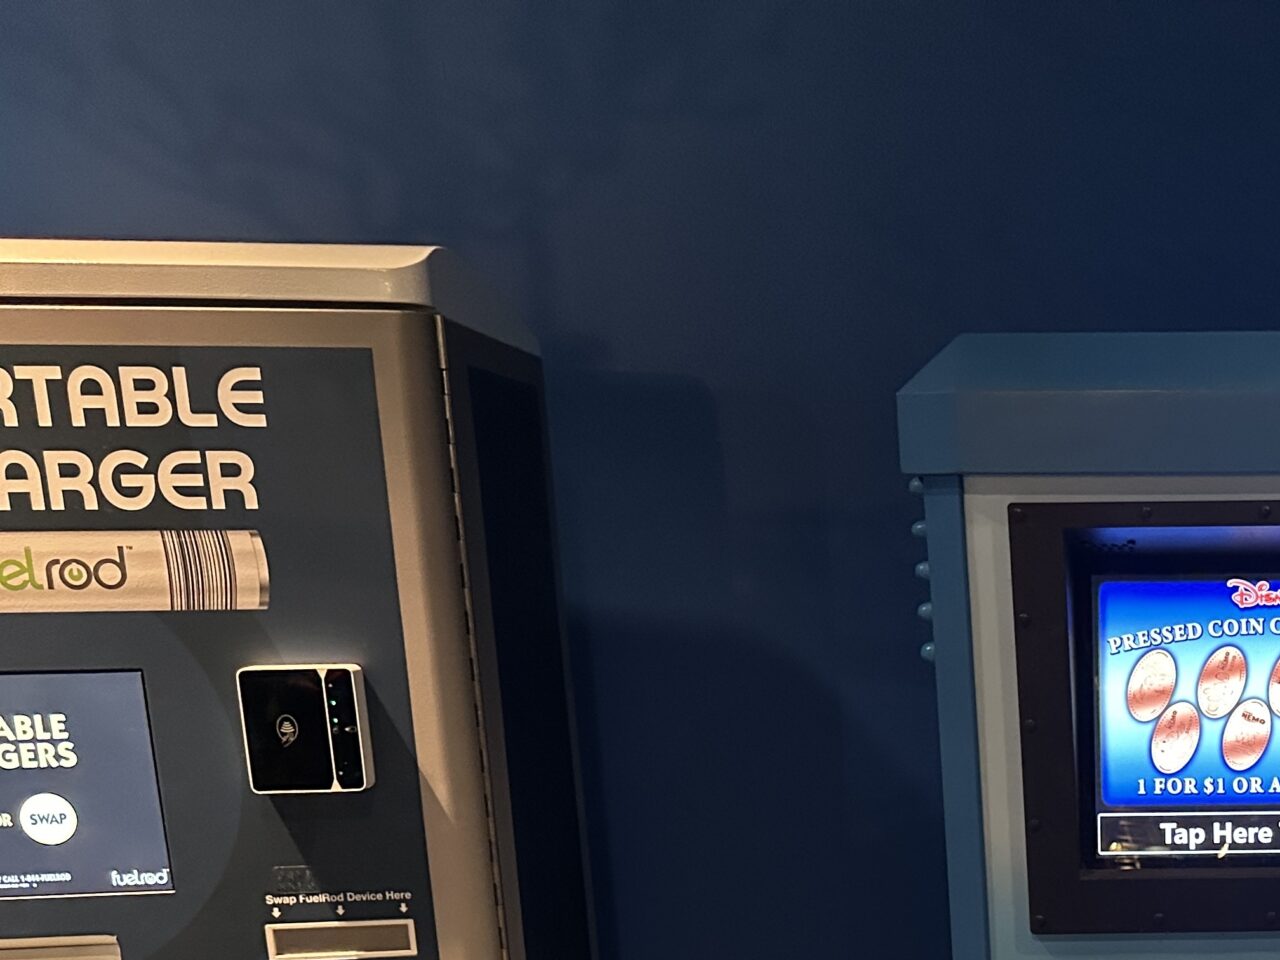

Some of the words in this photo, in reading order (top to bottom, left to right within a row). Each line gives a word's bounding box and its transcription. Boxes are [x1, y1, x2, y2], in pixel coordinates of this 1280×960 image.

[1107, 622, 1202, 655] PRESSED
[1208, 617, 1264, 637] COIN
[1241, 712, 1266, 725] NEMO
[0, 741, 78, 769] GERS
[1138, 778, 1147, 795] 1
[1154, 778, 1198, 795] FOR
[1203, 776, 1226, 796] $1
[1232, 777, 1265, 794] OR
[30, 813, 67, 825] SWAP
[1159, 821, 1206, 849] Tap
[1213, 821, 1272, 845] Here
[265, 894, 297, 906] Swap
[299, 892, 344, 904] FuelRod
[347, 891, 383, 901] Device
[386, 890, 412, 900] Here
